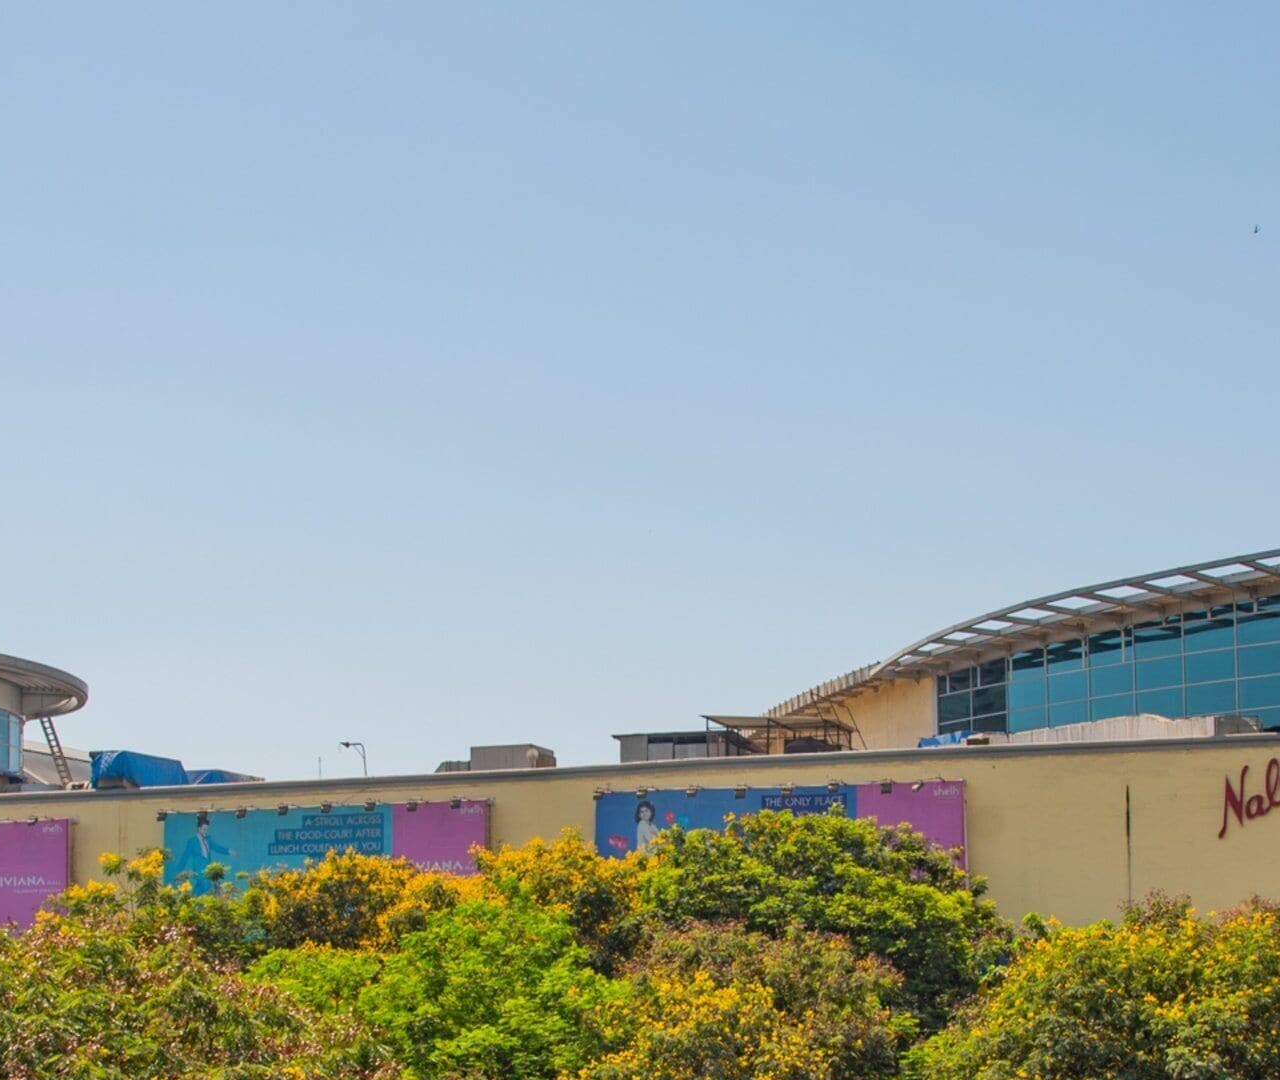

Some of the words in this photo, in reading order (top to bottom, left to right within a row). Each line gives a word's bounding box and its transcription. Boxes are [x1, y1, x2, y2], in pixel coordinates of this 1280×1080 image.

[764, 797, 781, 807] THE
[785, 796, 811, 806] ONLY
[346, 813, 381, 825] ACROSS
[277, 830, 292, 840] THE
[356, 828, 381, 838] AFTER
[270, 843, 300, 854] LUNCH
[362, 841, 381, 851] YOU
